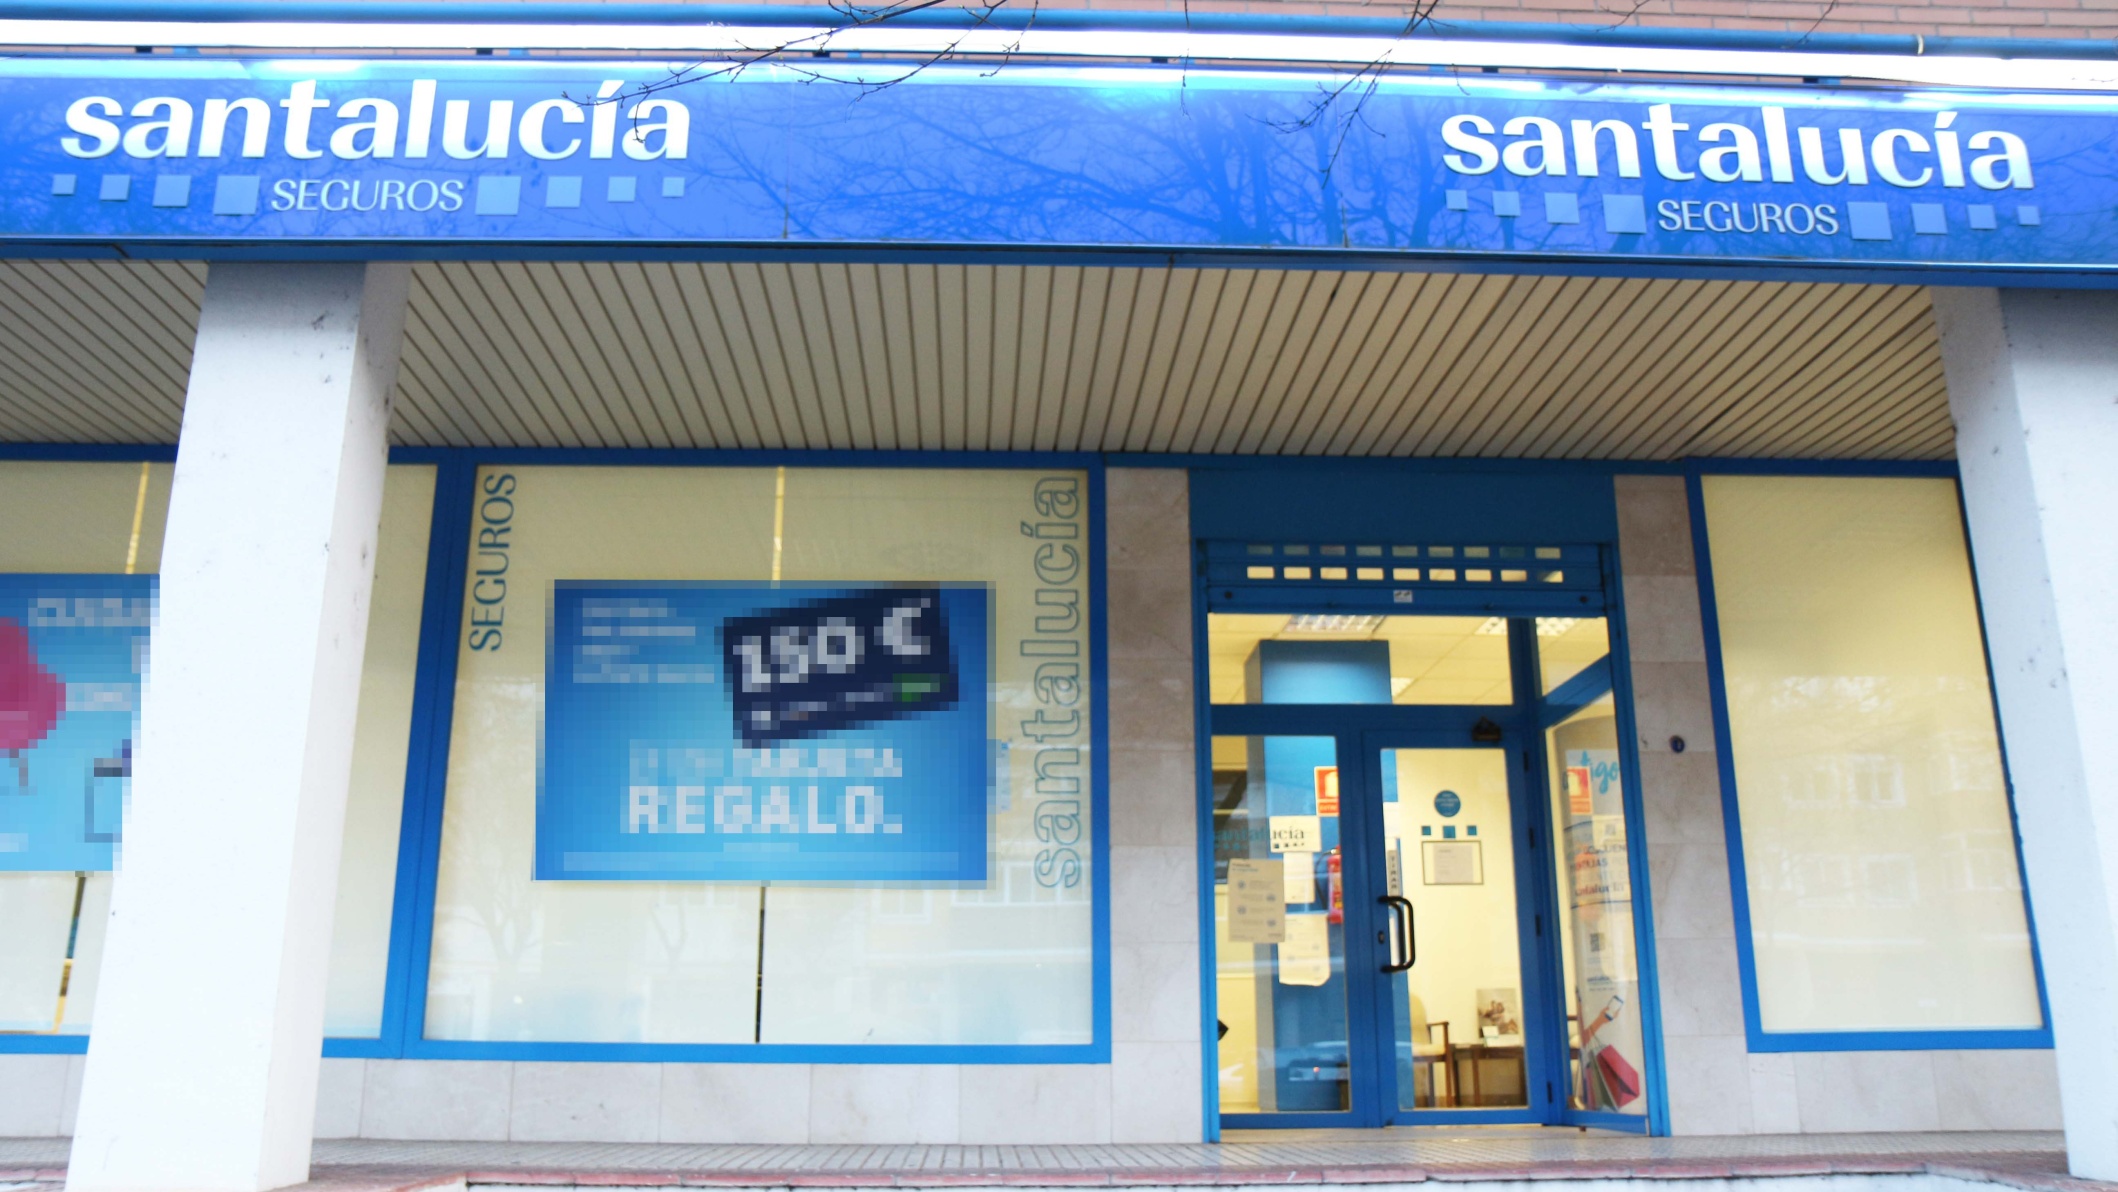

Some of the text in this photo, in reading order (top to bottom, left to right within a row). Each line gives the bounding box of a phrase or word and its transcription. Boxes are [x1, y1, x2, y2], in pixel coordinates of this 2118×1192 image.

[60, 79, 691, 161] santalucía
[1441, 103, 2035, 190] santalucía
[271, 178, 464, 214] SEGUROS
[1657, 199, 1839, 236] SEGUROS
[469, 473, 517, 652] SEGUROS
[1020, 476, 1082, 889] santalucía
